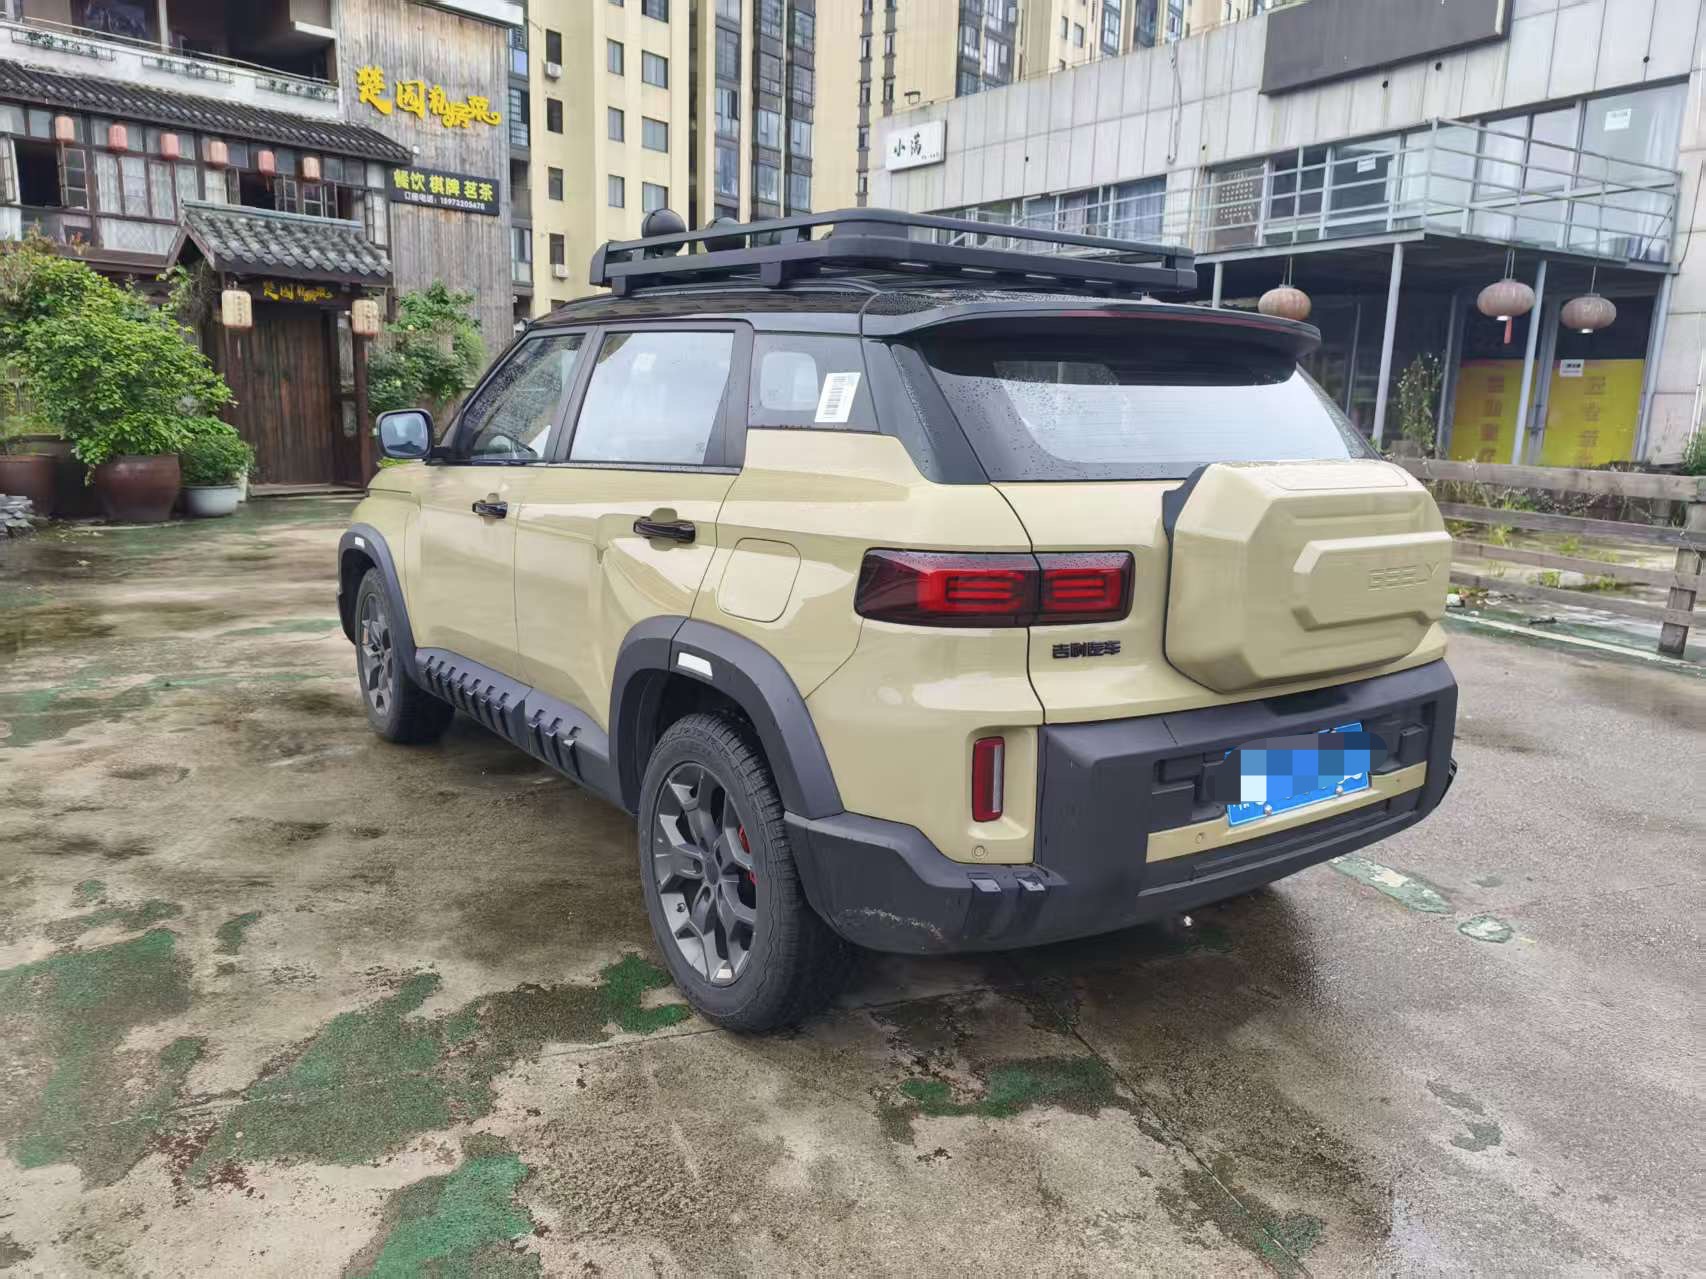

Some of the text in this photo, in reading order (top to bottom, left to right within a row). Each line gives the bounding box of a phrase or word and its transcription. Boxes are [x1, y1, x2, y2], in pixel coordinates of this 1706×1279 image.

[393, 168, 493, 201] 餐饮 棋牌 茗茶
[1367, 560, 1440, 592] GEELY
